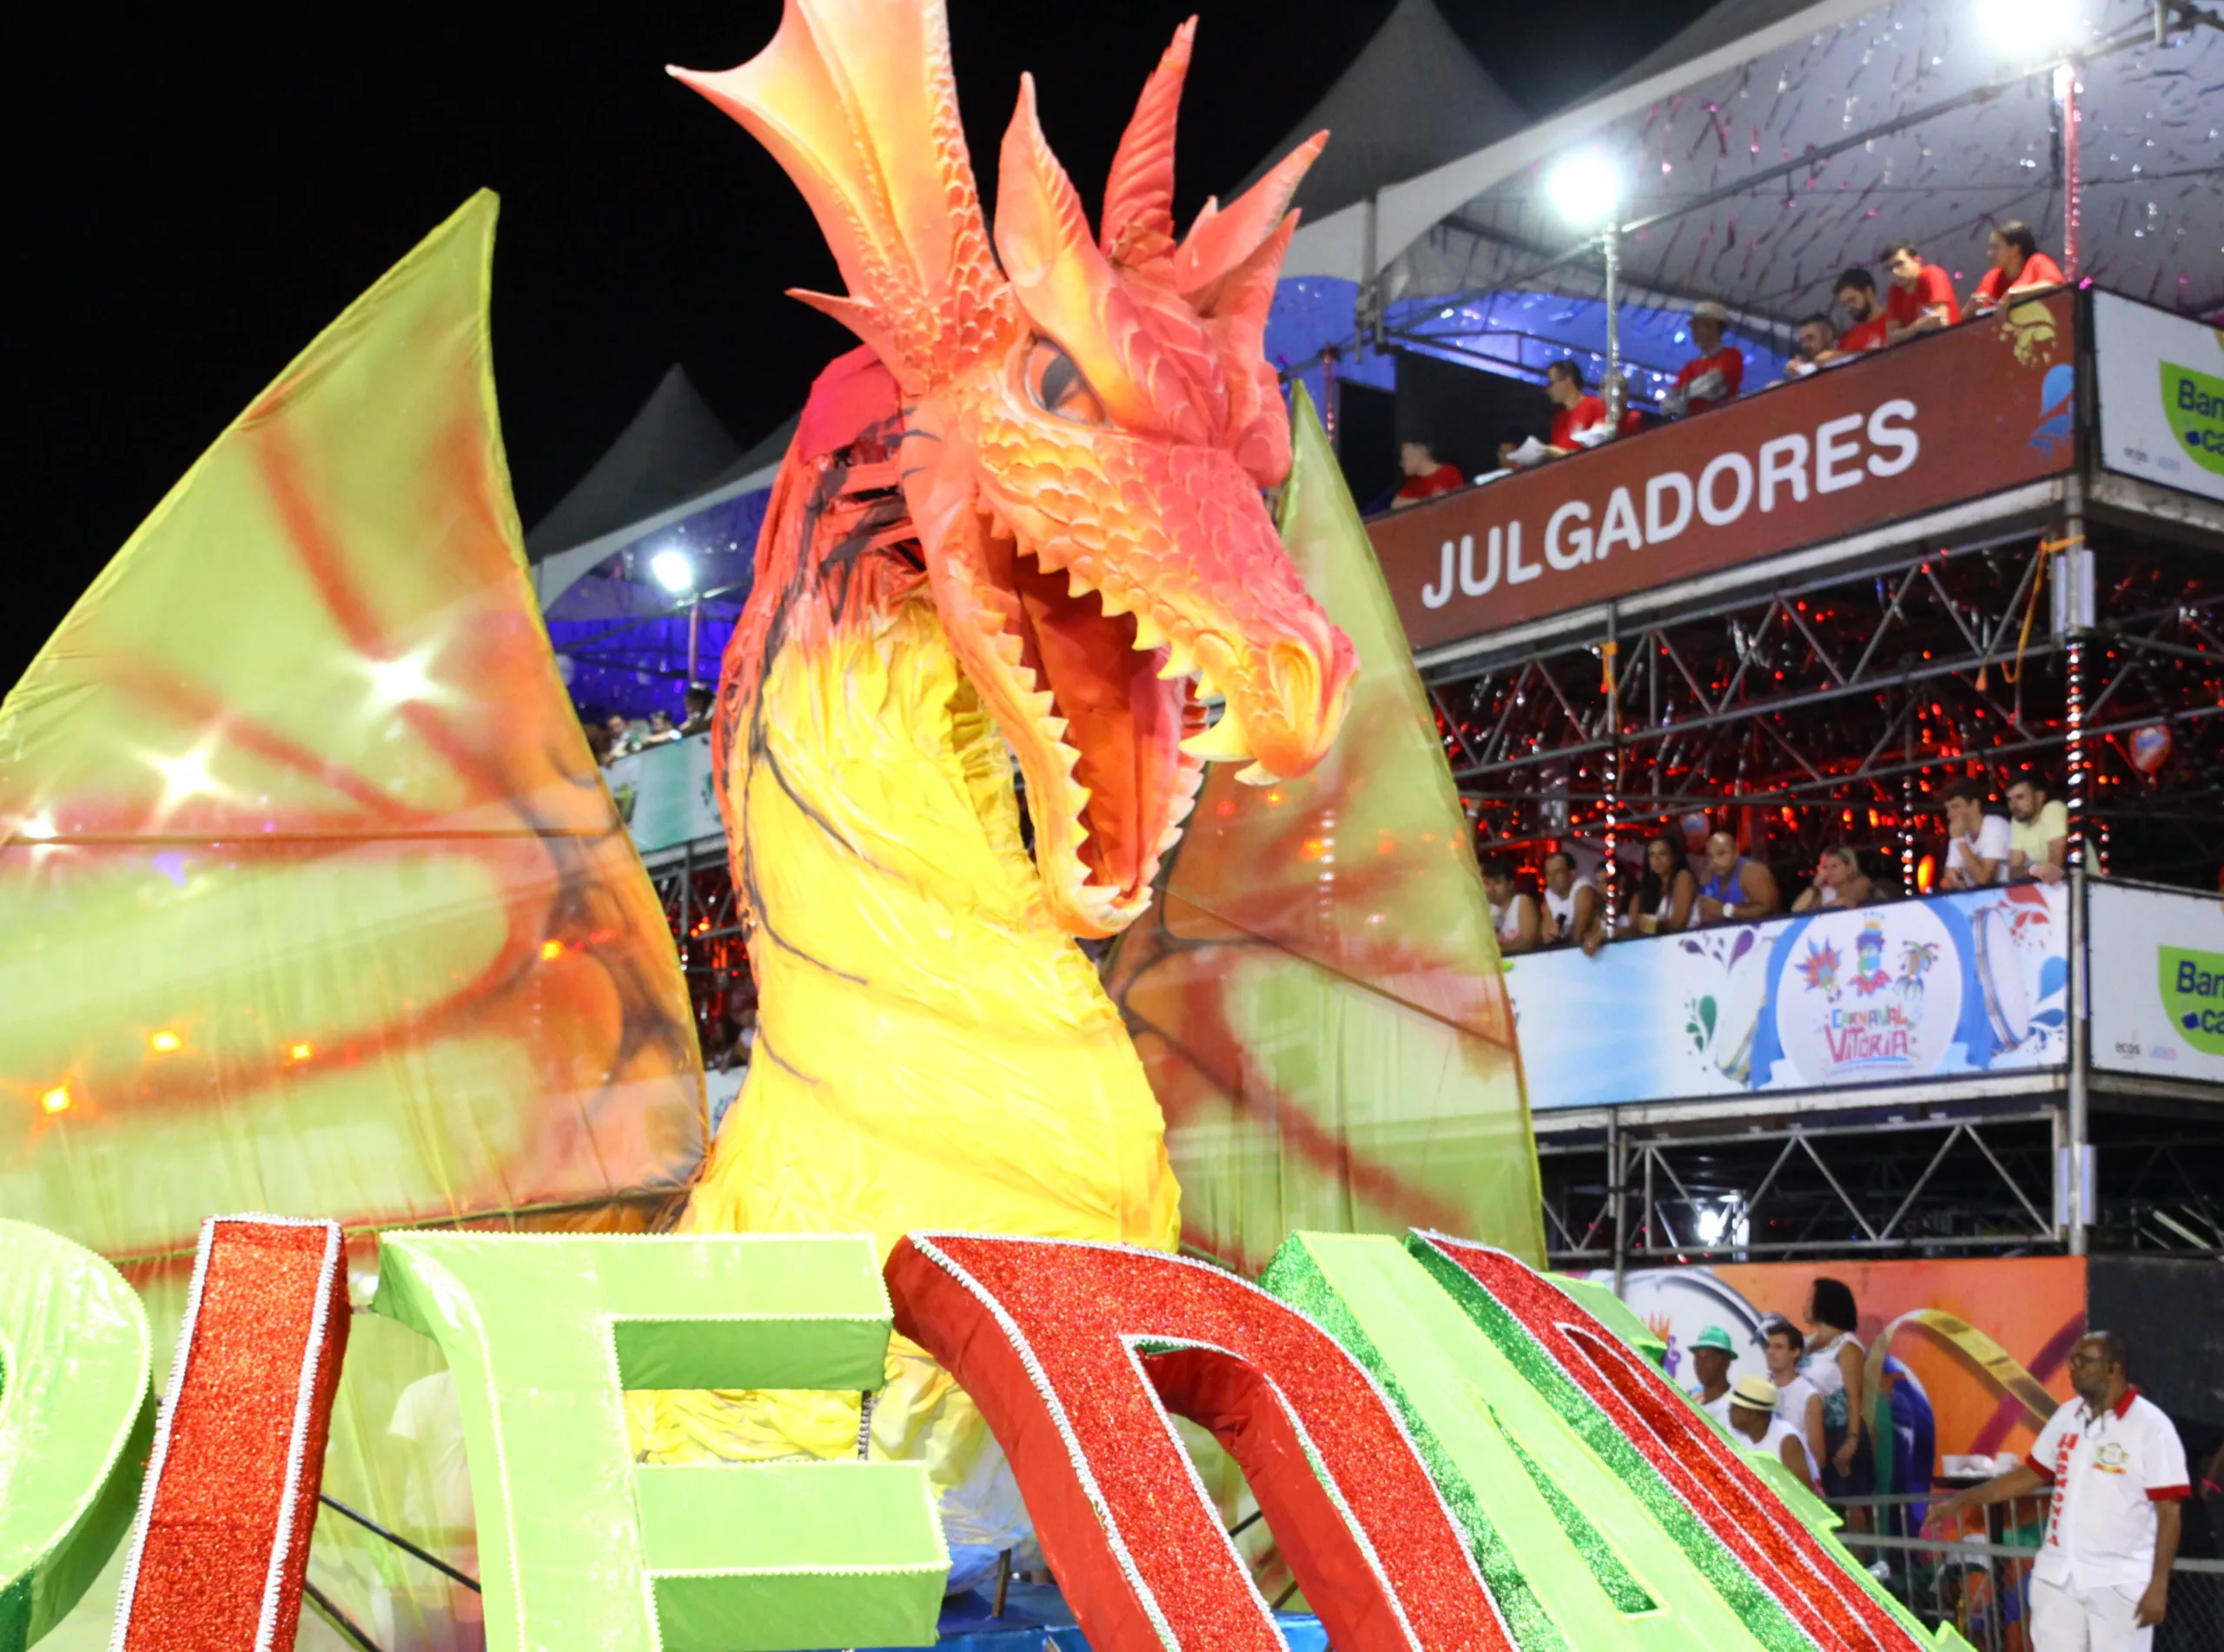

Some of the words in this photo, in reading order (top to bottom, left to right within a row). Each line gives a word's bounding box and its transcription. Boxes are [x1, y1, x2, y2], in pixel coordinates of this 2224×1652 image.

[1422, 400, 1919, 609] JULGADORES
[1831, 1004, 1909, 1028] CARNAVAL
[2048, 1432, 2079, 1547] HARMONIA
